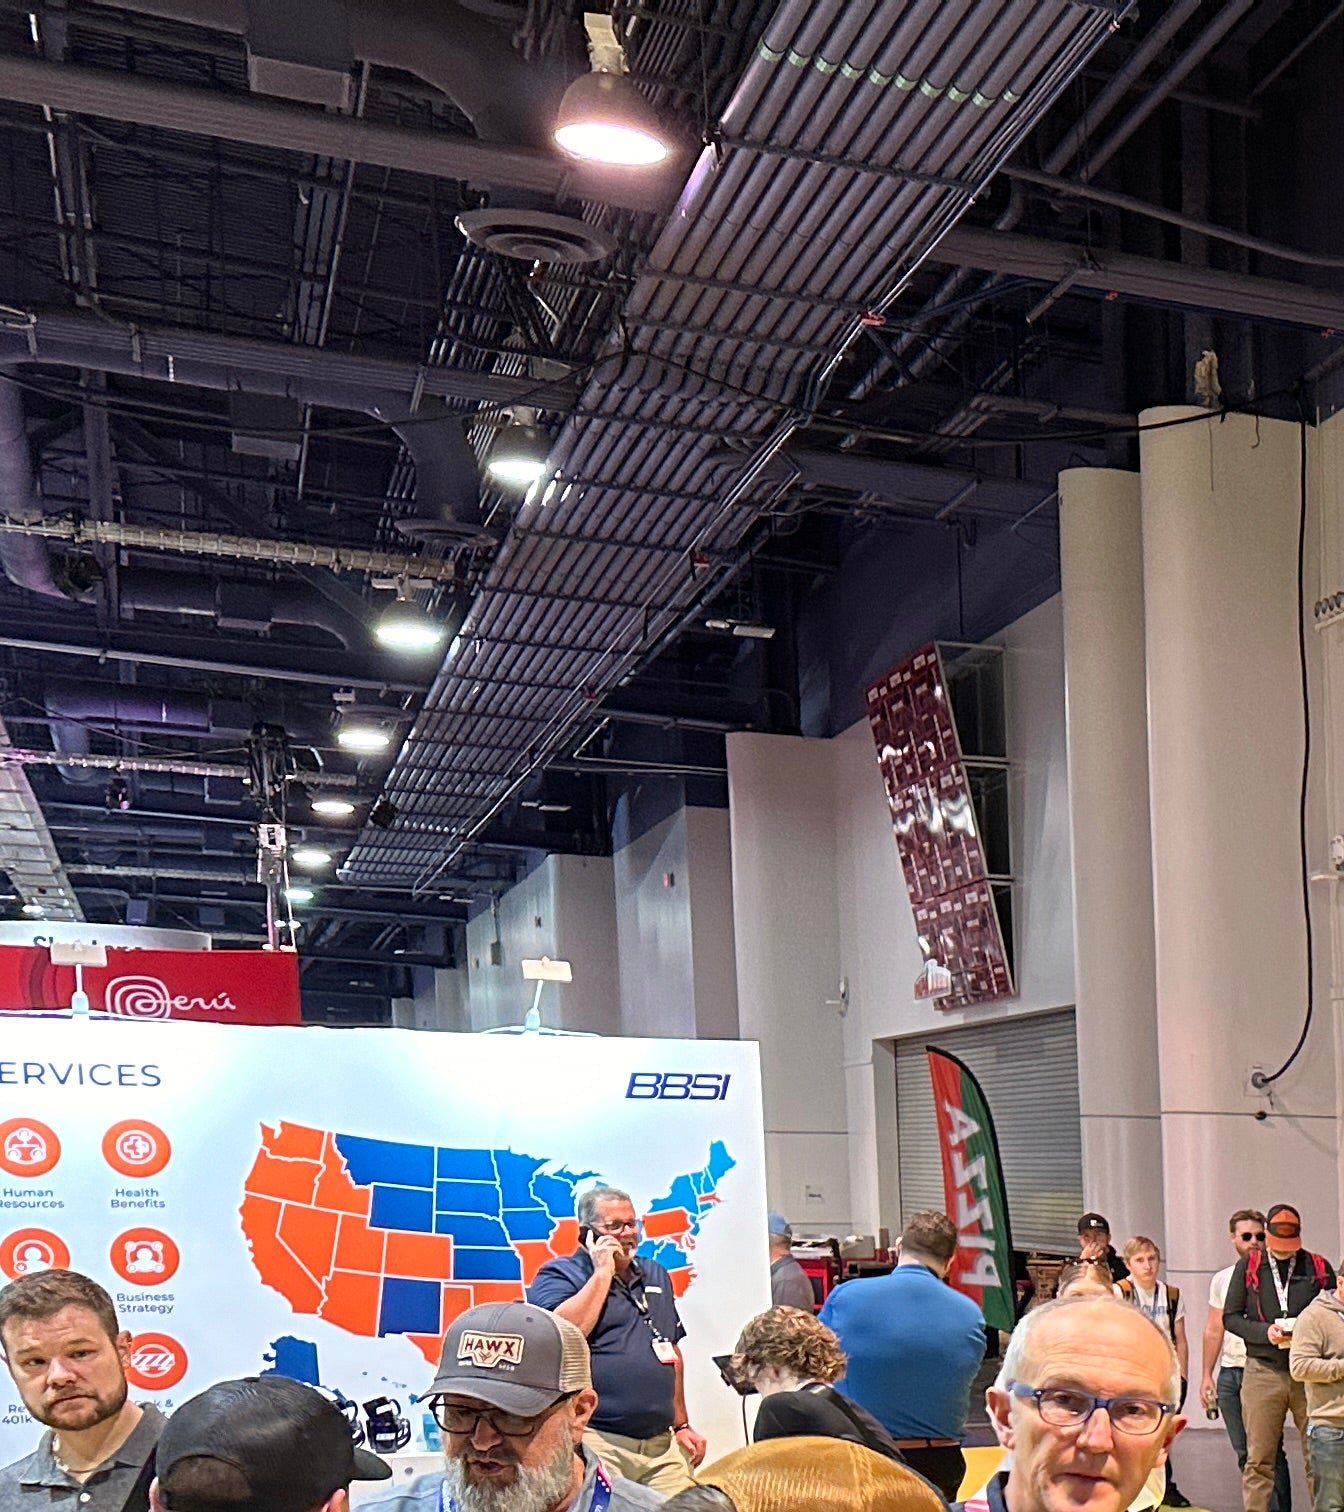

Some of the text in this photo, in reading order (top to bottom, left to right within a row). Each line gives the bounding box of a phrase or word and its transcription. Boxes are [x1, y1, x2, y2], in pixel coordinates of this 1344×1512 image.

[625, 1073, 731, 1100] BBSI
[3, 1188, 53, 1197] Human
[115, 1188, 159, 1197] Health
[110, 1199, 165, 1208] Benefits
[116, 1293, 175, 1301] Business
[119, 1303, 173, 1314] Strategy
[465, 1338, 515, 1357] HAWX
